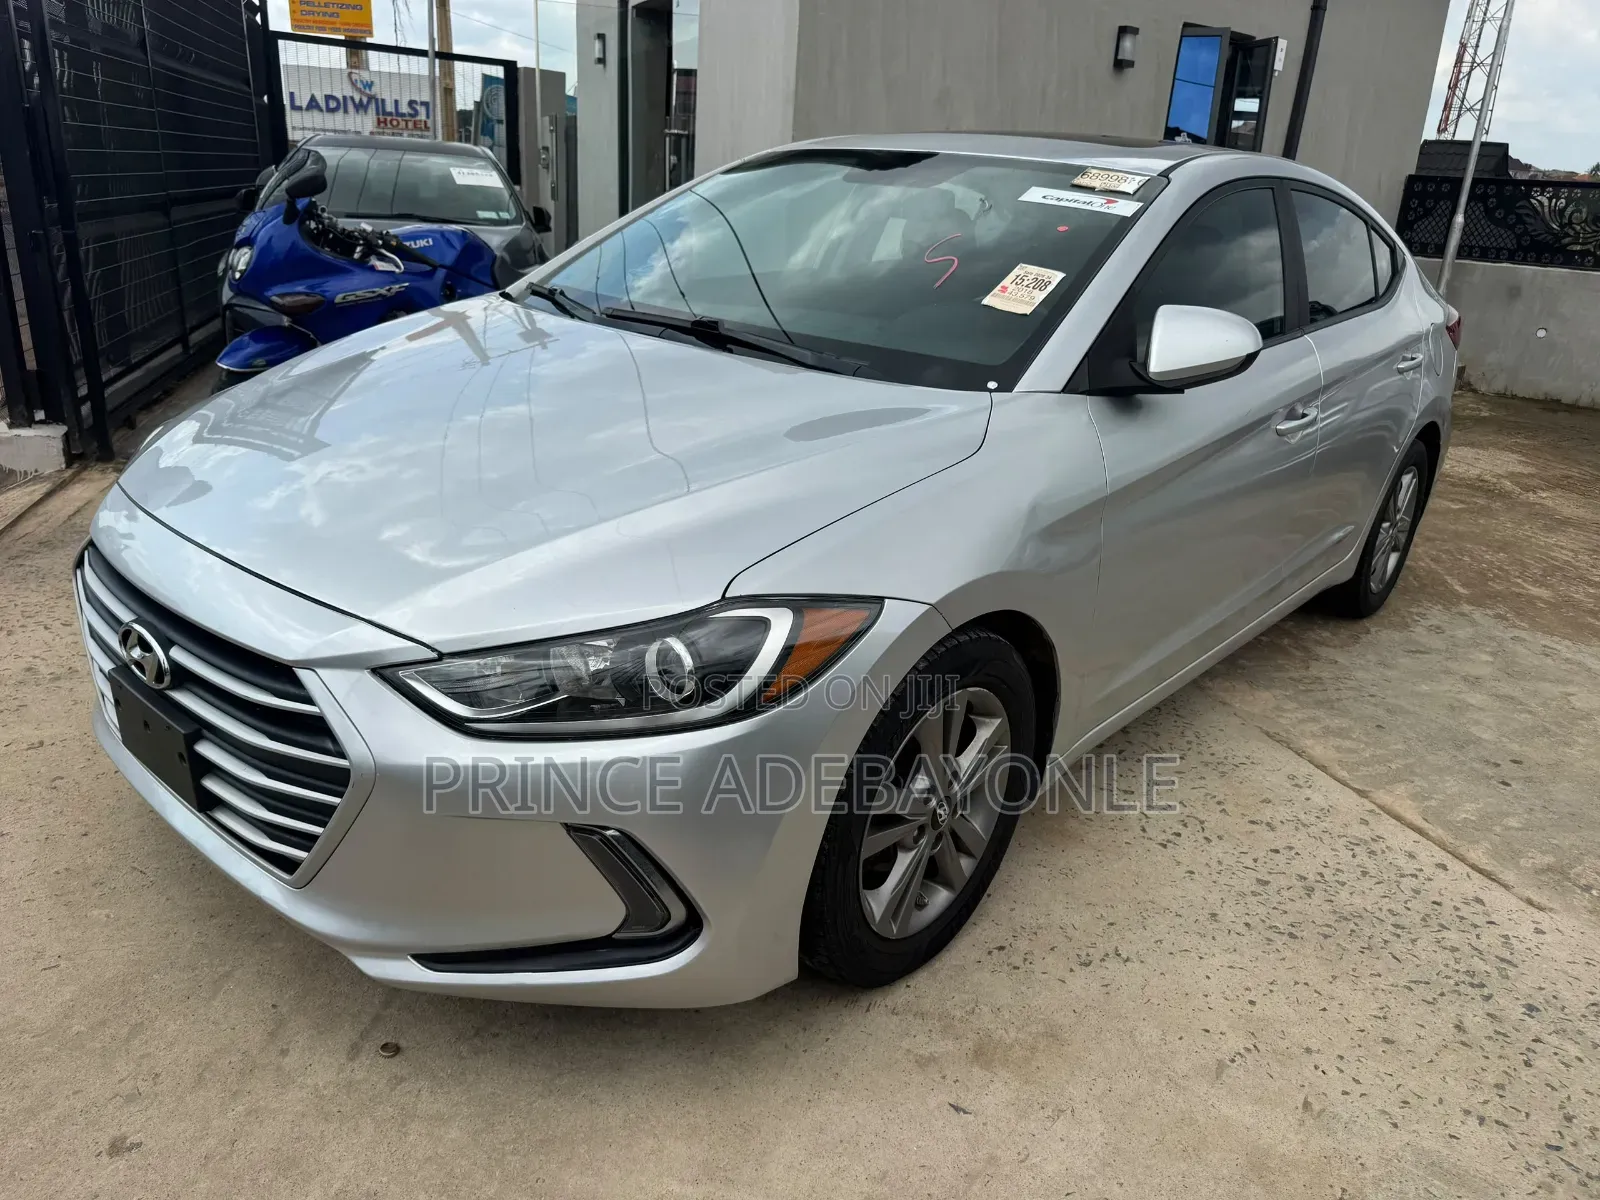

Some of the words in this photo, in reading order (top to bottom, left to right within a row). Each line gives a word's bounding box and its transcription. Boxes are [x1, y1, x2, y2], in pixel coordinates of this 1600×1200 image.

[300, 0, 363, 10] PELLETIZING
[301, 9, 340, 18] DRYING
[376, 117, 430, 130] HOTEL
[403, 238, 433, 248] ZUKI
[1010, 274, 1051, 292] 15:208
